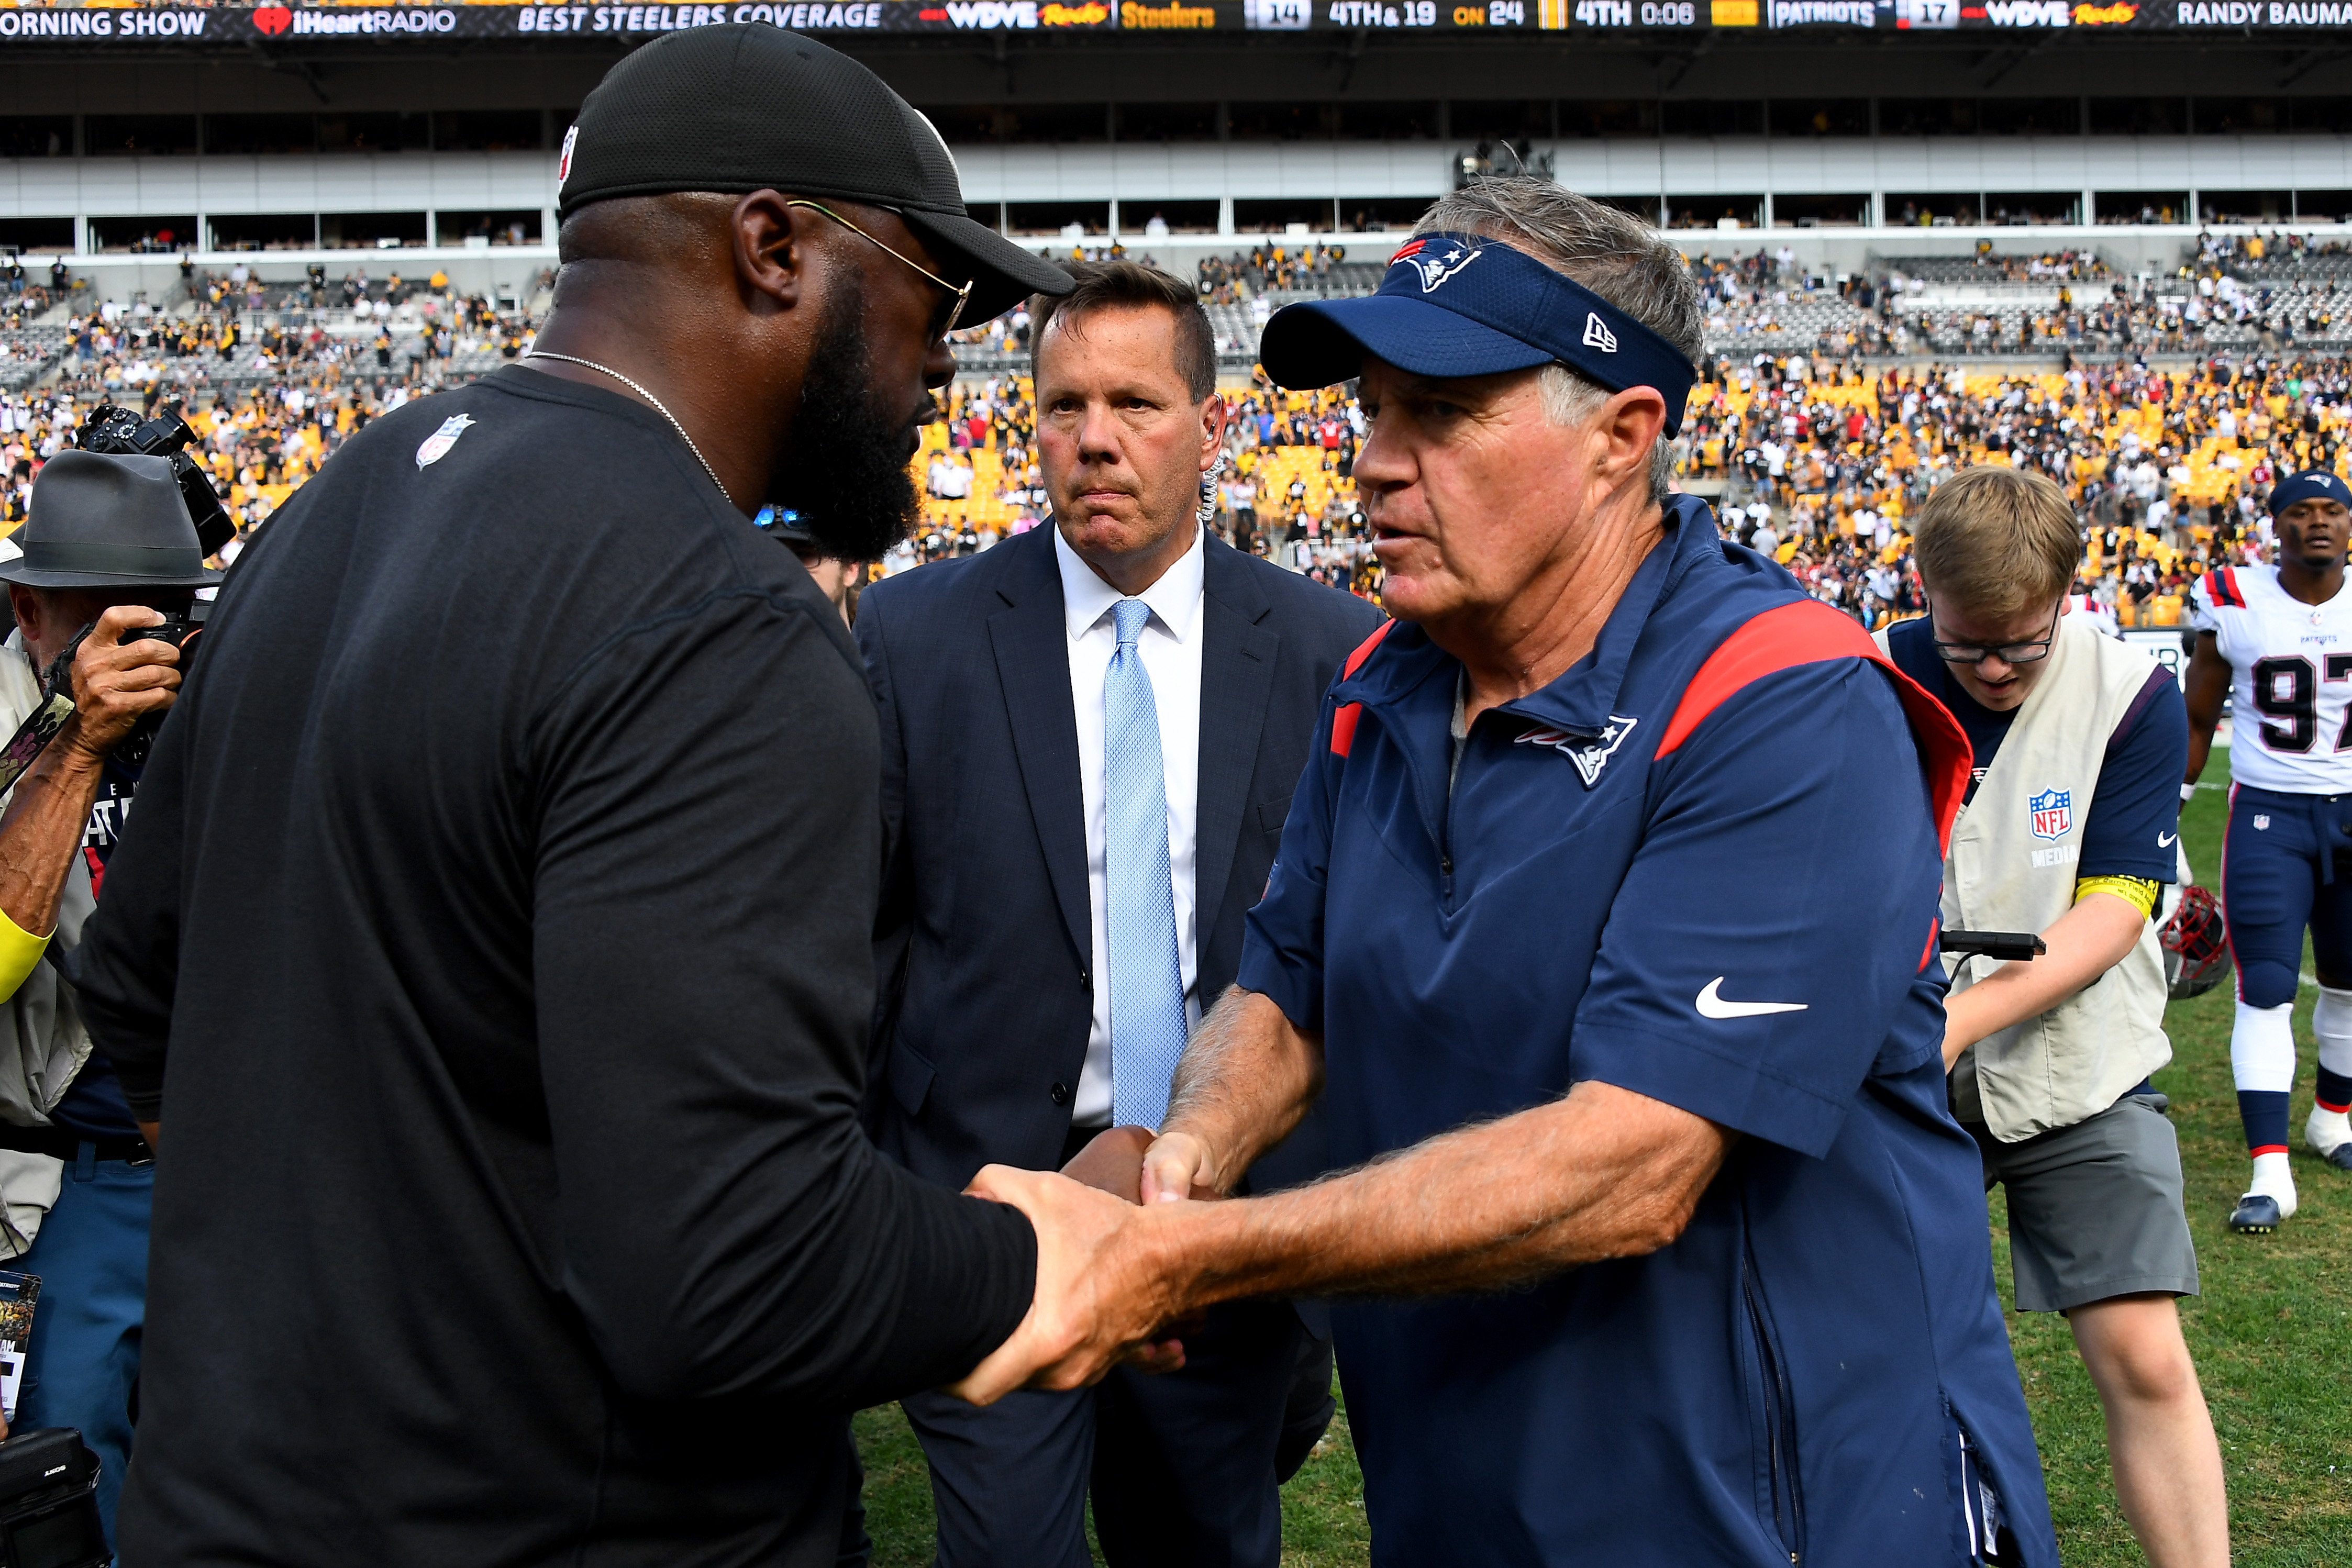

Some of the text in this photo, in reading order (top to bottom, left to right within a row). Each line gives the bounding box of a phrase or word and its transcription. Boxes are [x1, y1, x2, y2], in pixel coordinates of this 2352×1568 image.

[118, 10, 206, 36] SHOW
[293, 9, 456, 34] iHeartRADIO
[517, 3, 883, 32] BEST STEELERS COVERAGE
[945, 1, 1038, 29] WDVE
[1120, 1, 1215, 29] Steelers
[1270, 4, 1299, 24] 14
[1403, 1, 1437, 26] 19
[1453, 6, 1485, 26] ON
[1489, 1, 1526, 26] 24
[1575, 1, 1632, 27] 4TH
[1776, 1, 1876, 28] PATRIOTS
[1921, 4, 1947, 23] 17
[1985, 1, 2070, 27] WDVE
[2178, 1, 2263, 25] RANDY
[2034, 809, 2068, 835] NFL
[2031, 844, 2079, 869] MEDIA
[44, 1464, 66, 1477] SONY
